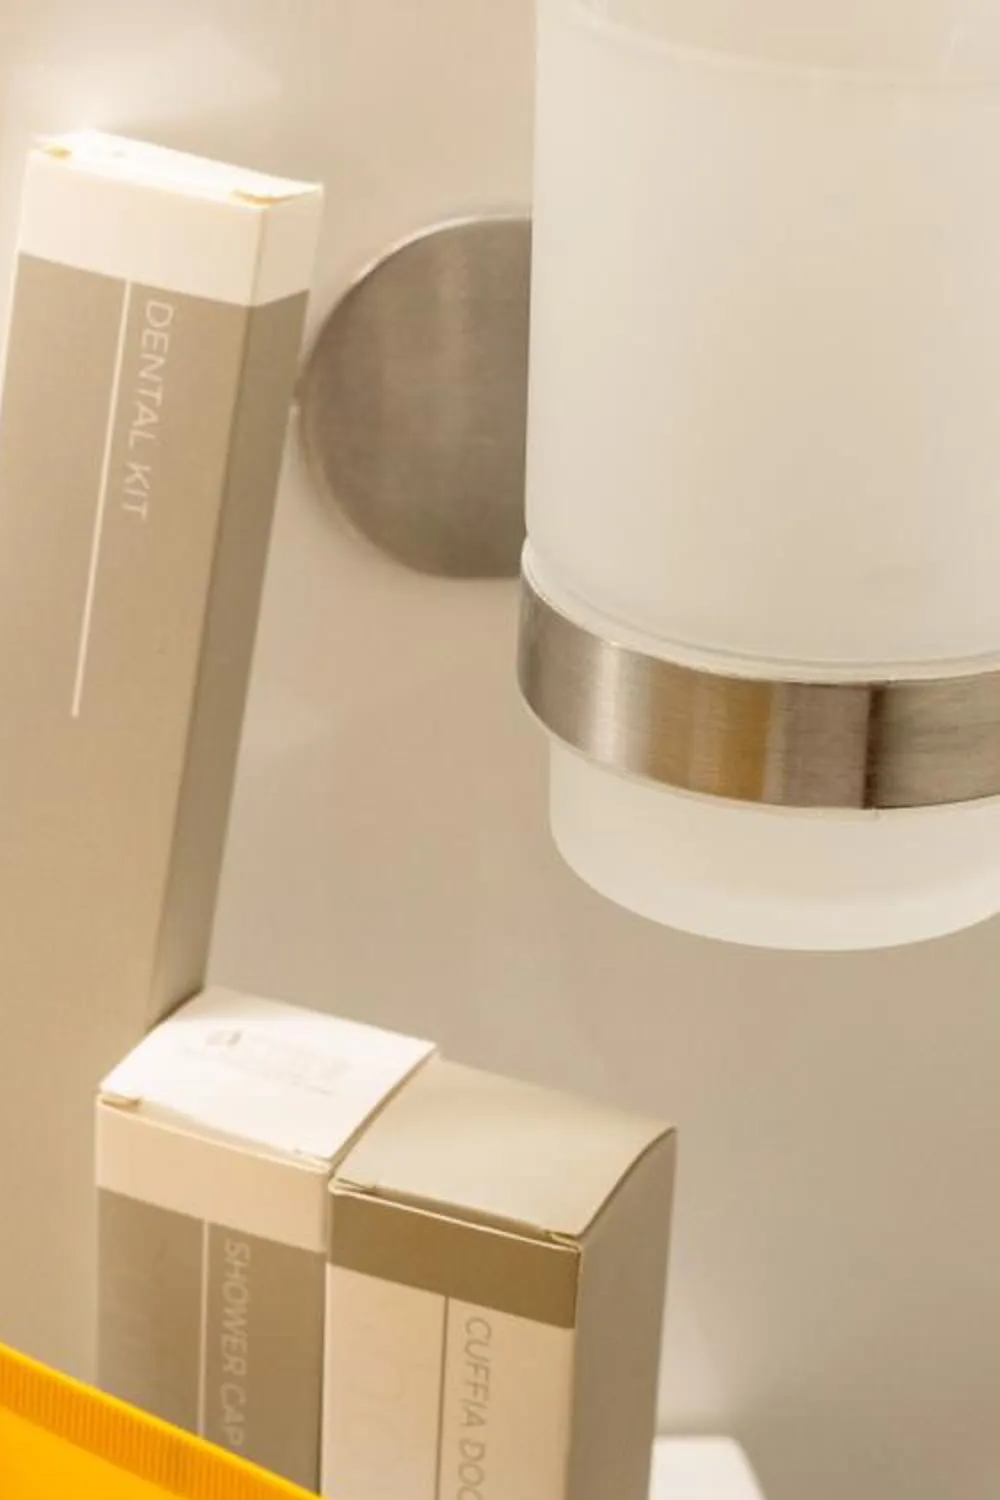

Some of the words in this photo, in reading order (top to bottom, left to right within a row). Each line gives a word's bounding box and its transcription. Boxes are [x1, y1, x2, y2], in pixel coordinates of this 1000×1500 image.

[128, 298, 174, 449] DENTAL
[121, 460, 152, 521] KIT
[220, 1238, 251, 1377] SHOWER
[219, 1382, 247, 1446] CAP
[461, 1316, 492, 1428] CUFFIA
